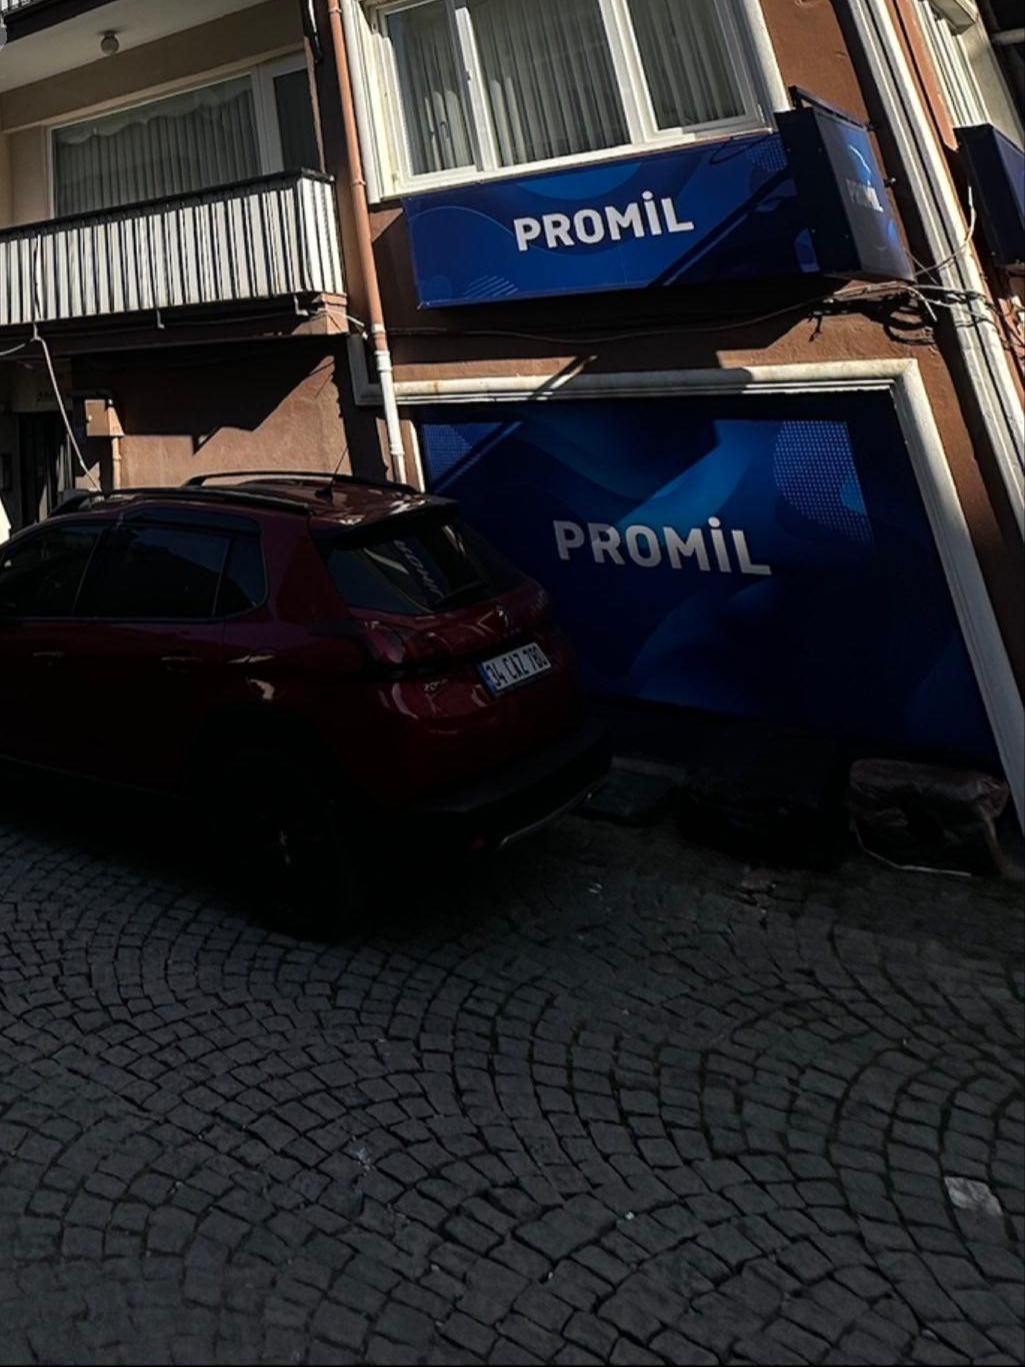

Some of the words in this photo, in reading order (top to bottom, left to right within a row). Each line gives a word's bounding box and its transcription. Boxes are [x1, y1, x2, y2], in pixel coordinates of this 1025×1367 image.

[513, 190, 695, 252] PROMİL
[553, 516, 772, 575] PROMİL
[486, 662, 508, 687] 34
